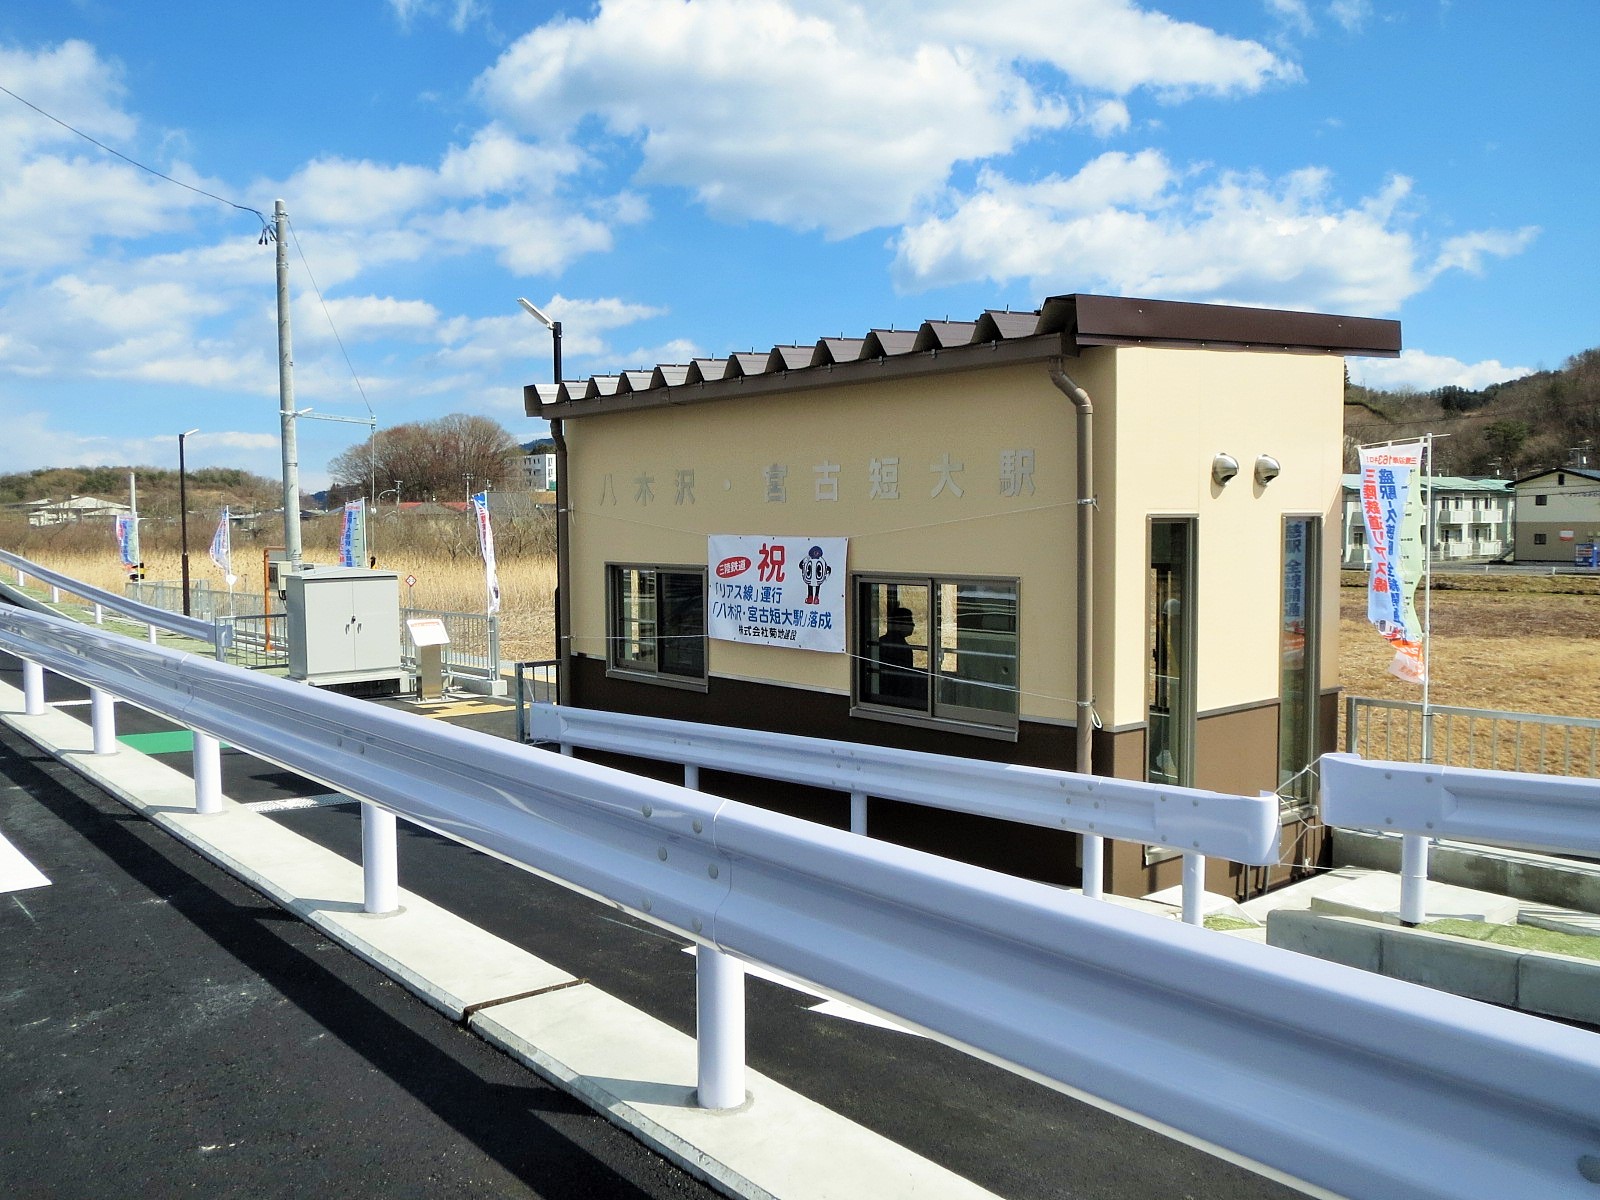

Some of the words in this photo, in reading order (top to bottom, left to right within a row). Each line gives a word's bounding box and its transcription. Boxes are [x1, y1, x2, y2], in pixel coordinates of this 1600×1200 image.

[600, 449, 1036, 506] 八木沢・宮古短大駅
[719, 559, 747, 576] 三陸鉄道
[757, 543, 786, 583] 祝
[714, 582, 783, 604] 「リアス線」運行
[712, 601, 832, 630] 「八木沢・宮古短大駅」落成
